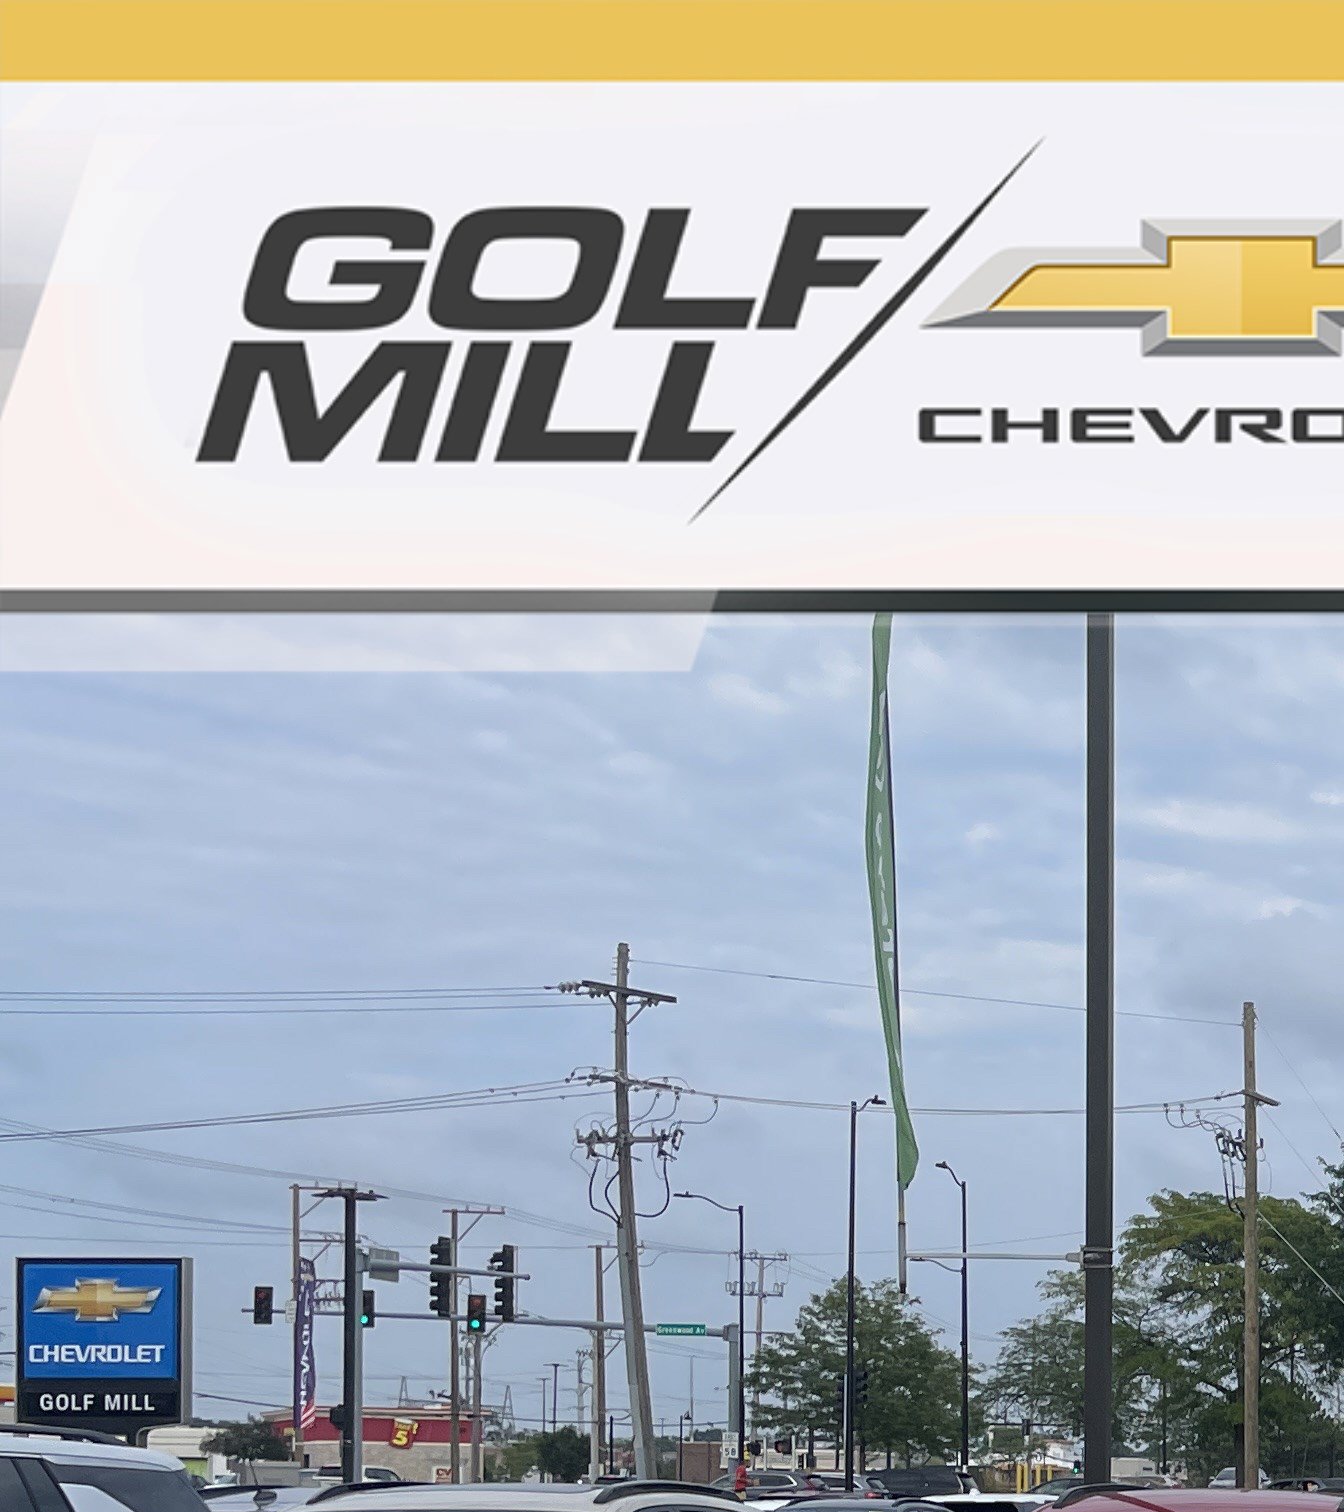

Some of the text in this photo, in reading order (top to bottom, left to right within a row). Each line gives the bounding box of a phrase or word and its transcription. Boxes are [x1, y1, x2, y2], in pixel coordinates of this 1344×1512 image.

[29, 1344, 165, 1363] CHEVROLET
[39, 1393, 155, 1411] GOLF MILL
